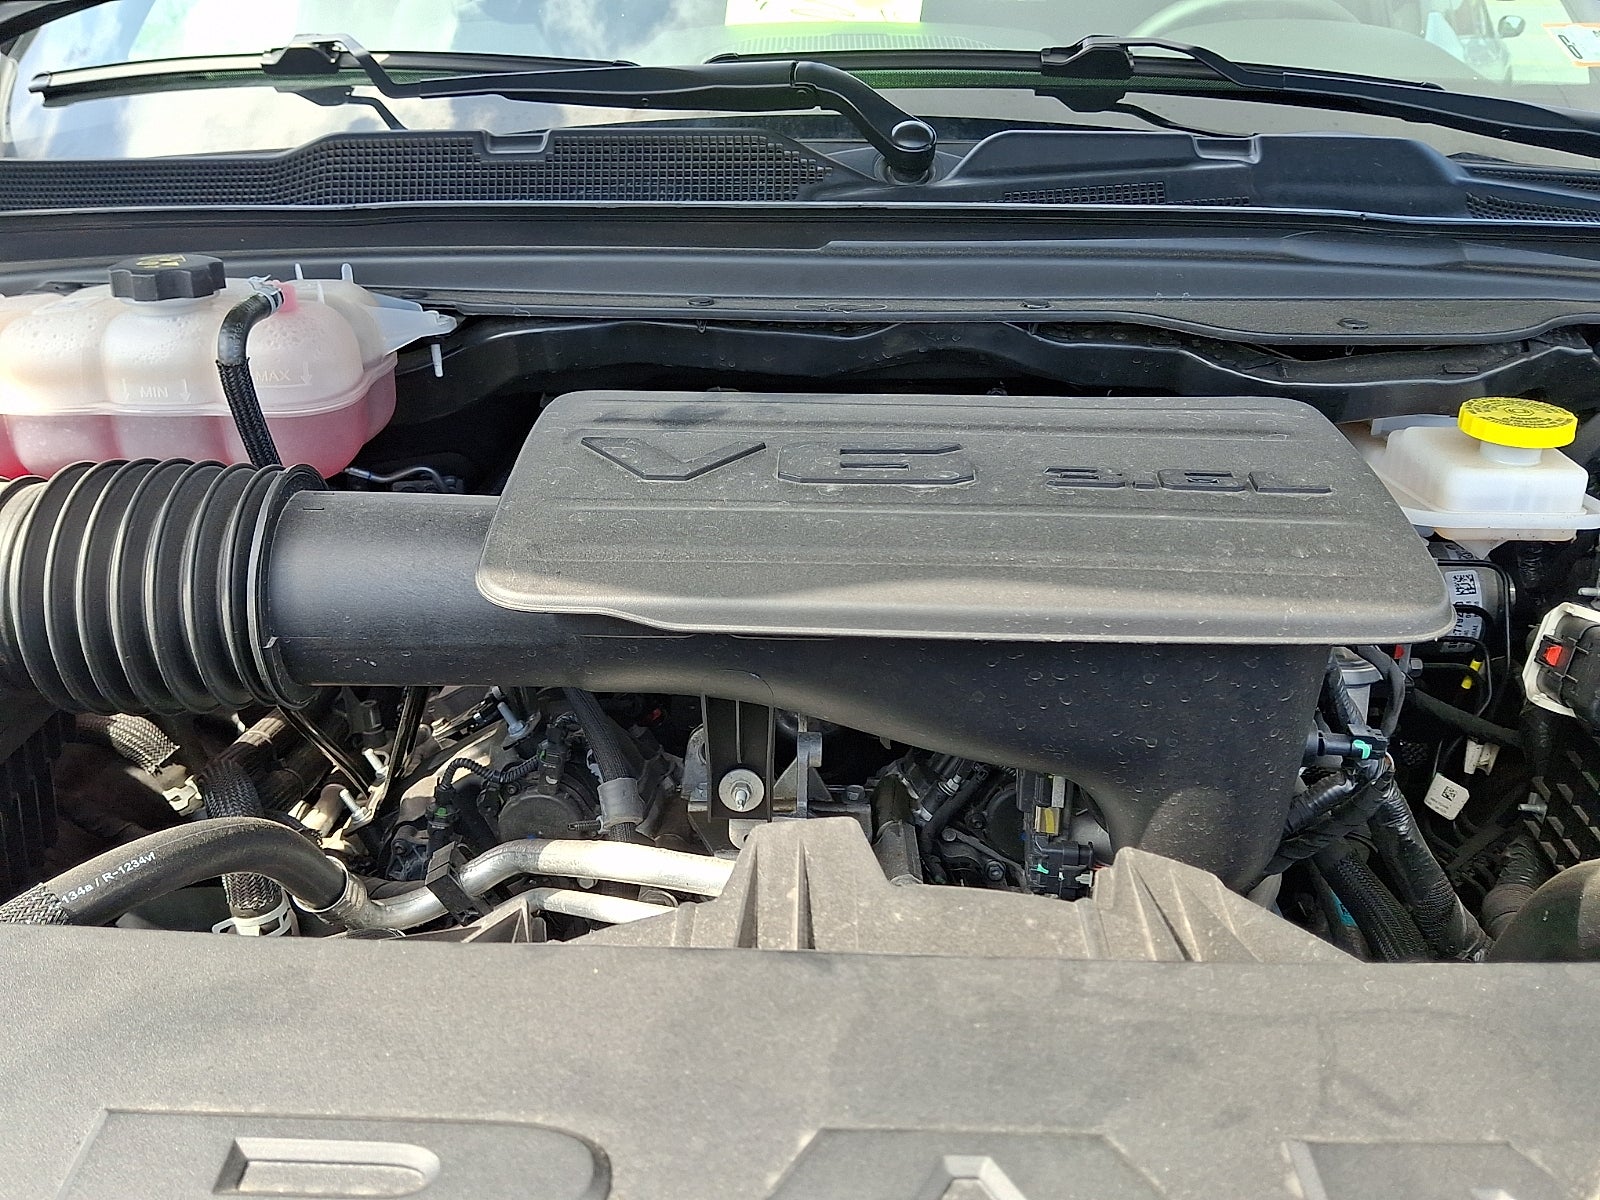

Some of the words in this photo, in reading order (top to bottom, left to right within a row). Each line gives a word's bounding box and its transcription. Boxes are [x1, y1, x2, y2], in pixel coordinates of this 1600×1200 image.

[256, 369, 291, 383] MAX
[139, 385, 169, 399] MIN
[56, 884, 94, 908] -134a
